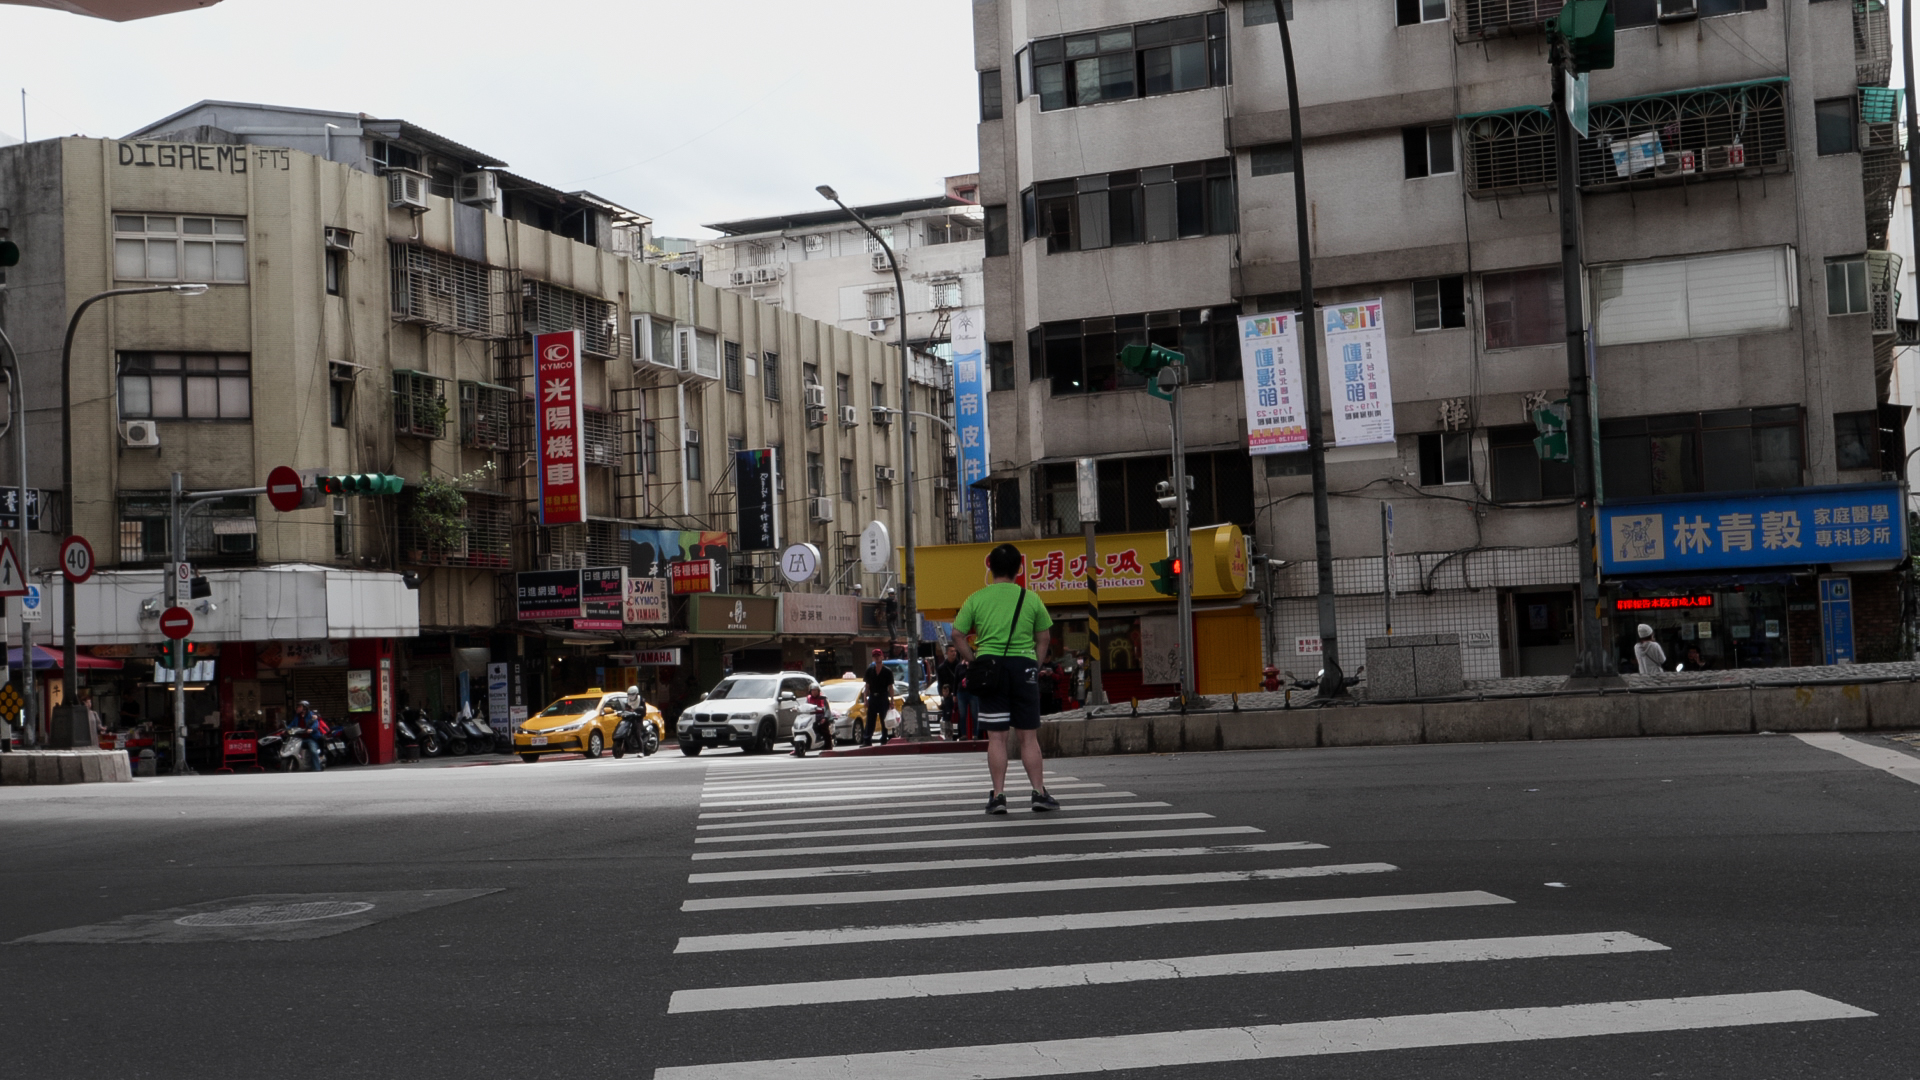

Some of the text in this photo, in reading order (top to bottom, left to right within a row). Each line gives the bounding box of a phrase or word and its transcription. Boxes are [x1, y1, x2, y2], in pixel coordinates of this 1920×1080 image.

[540, 361, 573, 371] KYMCO
[544, 378, 574, 486] 光陽機車
[1813, 504, 1889, 526] 家庭醫學
[1815, 527, 1891, 547] 專科診所
[67, 549, 87, 570] 40
[1030, 549, 1143, 582] 頂呱呱
[673, 562, 709, 577] 各種機車
[634, 580, 653, 593] SYM
[1030, 581, 1056, 592] TKK
[634, 595, 659, 606] KYMCO
[635, 608, 660, 621] YAMAHA
[635, 651, 672, 663] YAMAHA
